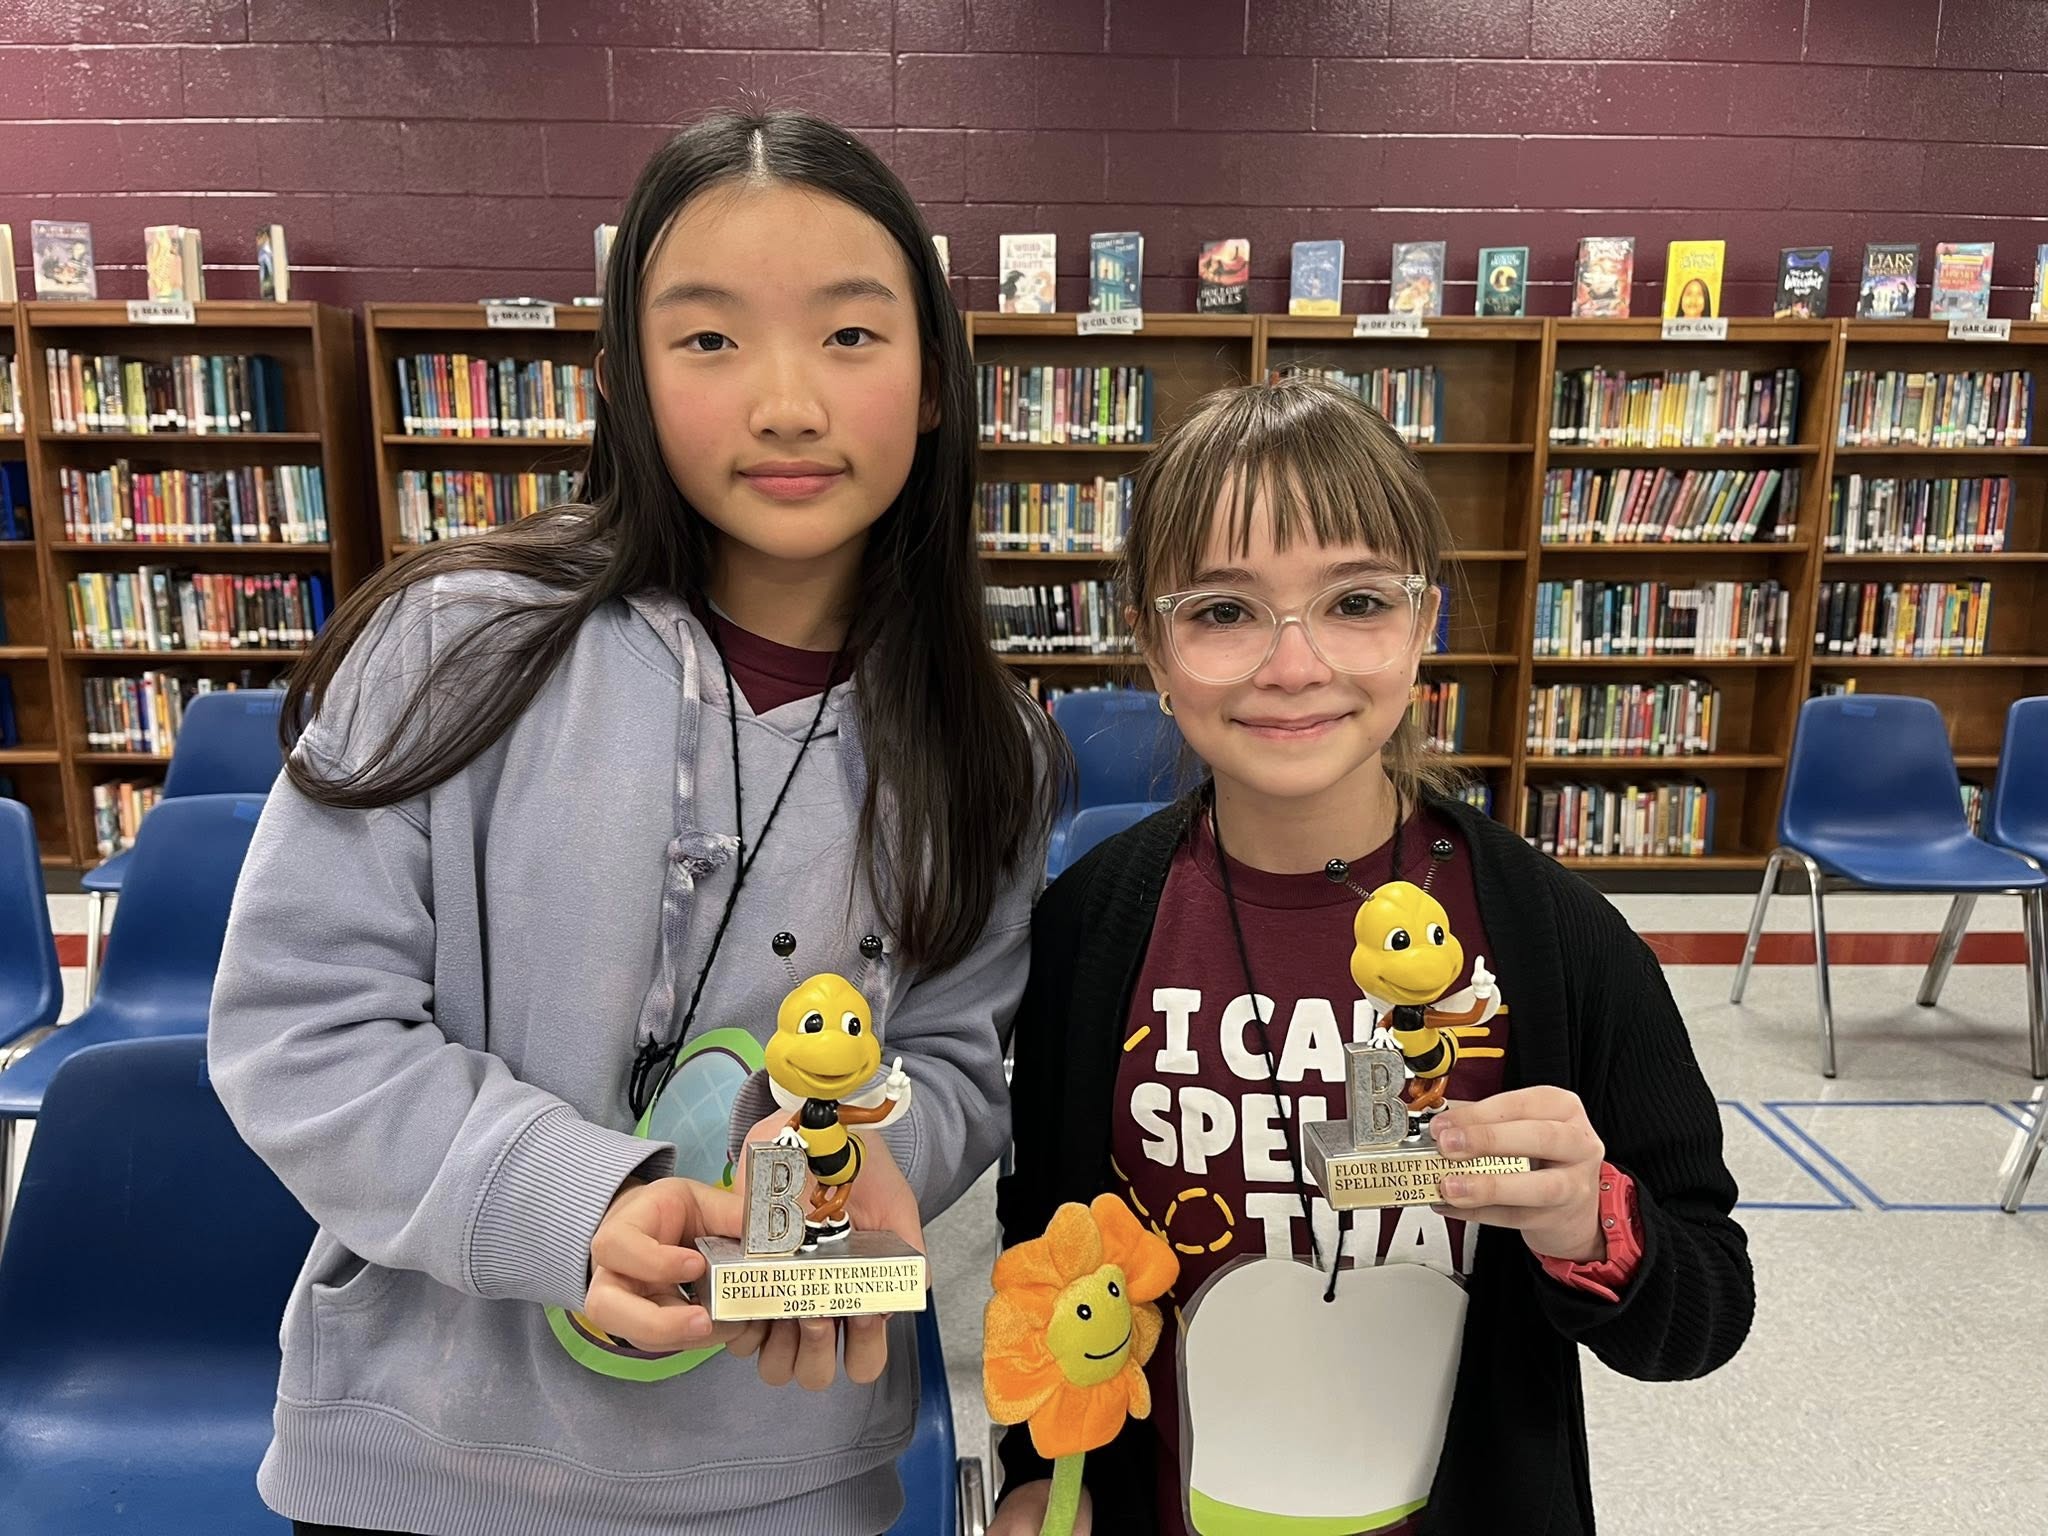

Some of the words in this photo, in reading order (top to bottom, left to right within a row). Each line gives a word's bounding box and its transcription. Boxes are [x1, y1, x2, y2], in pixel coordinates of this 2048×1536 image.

[1869, 253, 1914, 269] LIARS
[1152, 987, 1201, 1075] I
[1350, 1048, 1409, 1151] B
[1335, 1162, 1378, 1177] FLOUR
[1381, 1160, 1422, 1174] BLUFF
[1335, 1174, 1408, 1191] SPELLING
[1413, 1172, 1442, 1186] BEE
[744, 1146, 808, 1259] B
[1394, 1189, 1425, 1201] 2025
[723, 1269, 768, 1284] FLOUR
[772, 1268, 816, 1283] BLUFF
[819, 1264, 918, 1280] INTERMEDIATE
[721, 1284, 797, 1299] SPELLING
[801, 1282, 830, 1296] BEE
[834, 1279, 918, 1295] RUNNER-UP
[783, 1299, 816, 1312] 2025
[829, 1298, 862, 1311] 2026
